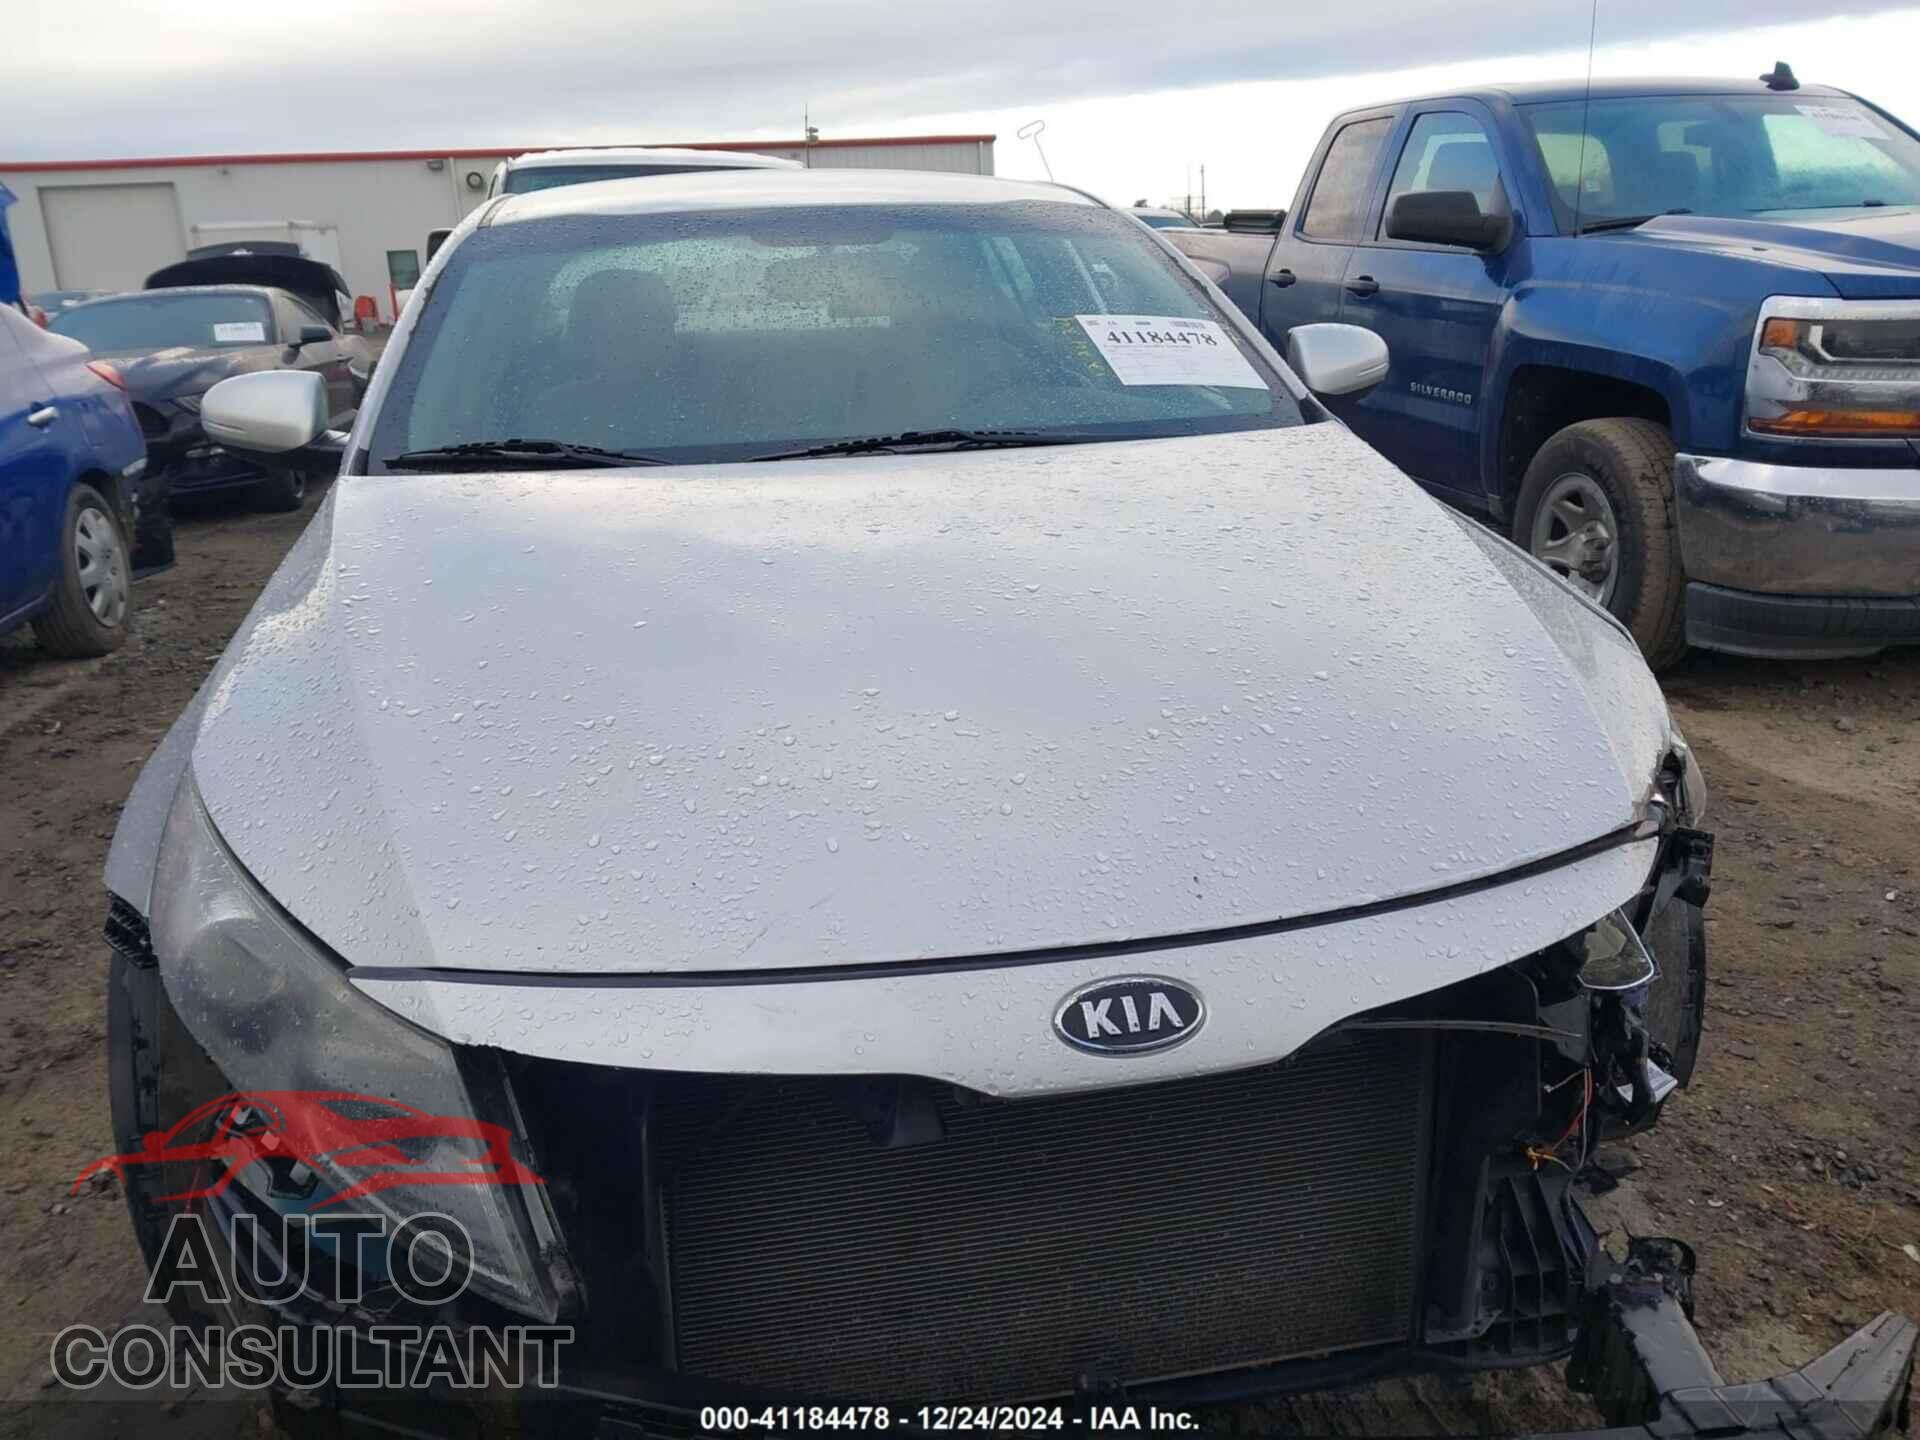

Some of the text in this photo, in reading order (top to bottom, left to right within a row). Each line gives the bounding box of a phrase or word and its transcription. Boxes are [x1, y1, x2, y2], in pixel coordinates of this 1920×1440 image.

[1106, 330, 1218, 346] 41184478
[1410, 381, 1472, 405] SILVERADO
[1080, 992, 1184, 1039] KIA
